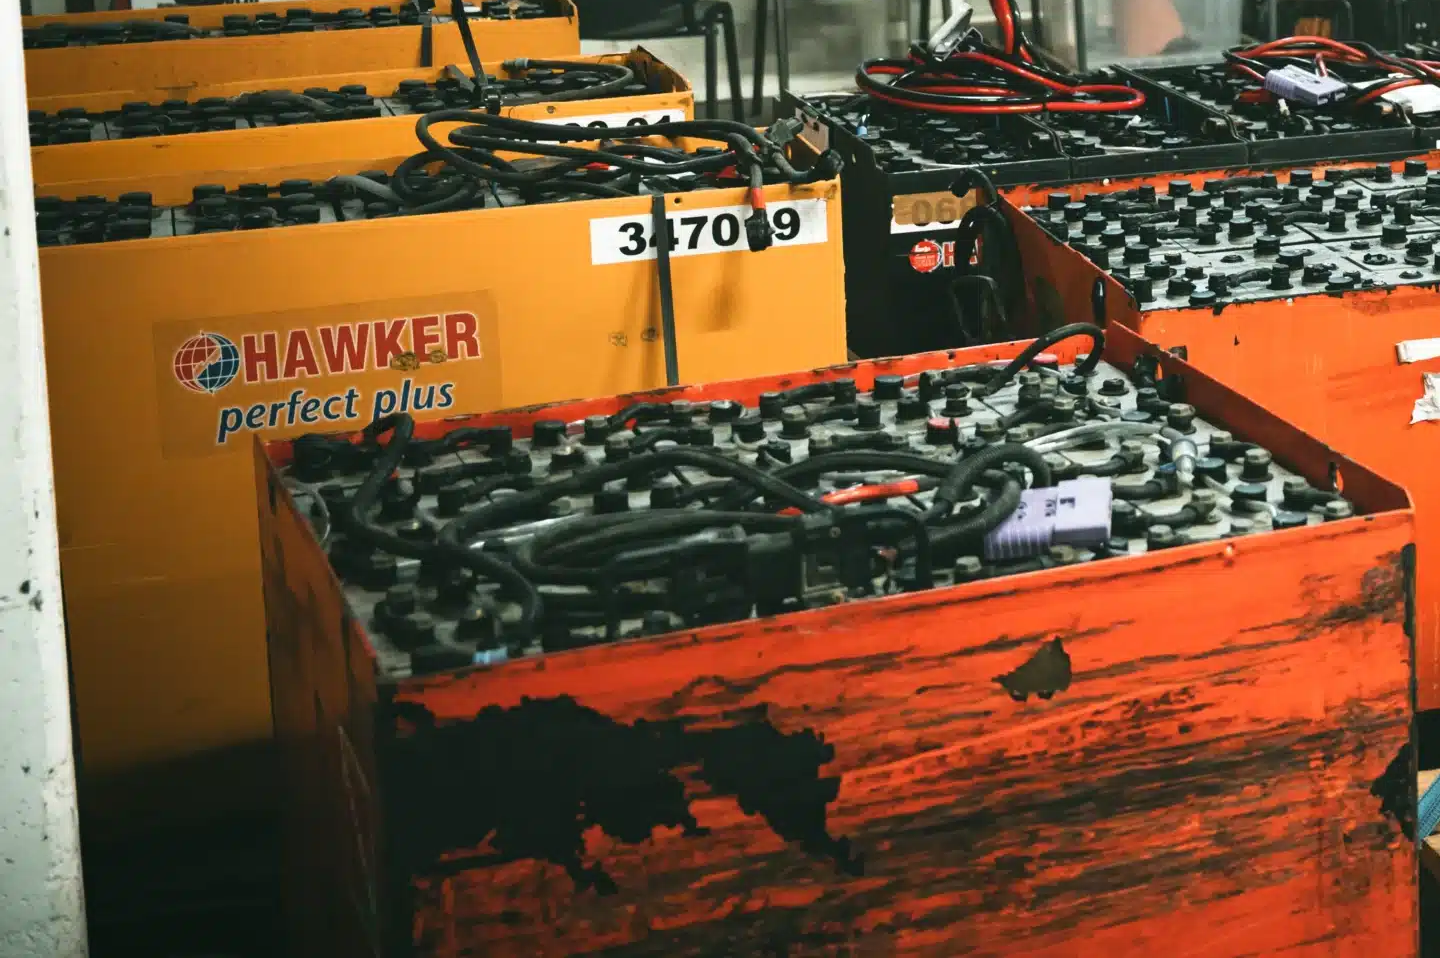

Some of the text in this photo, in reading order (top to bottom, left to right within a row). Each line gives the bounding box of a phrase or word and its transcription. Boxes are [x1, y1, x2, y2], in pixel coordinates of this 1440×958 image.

[242, 311, 481, 383] HAWKER
[216, 378, 454, 445] perfect plus
